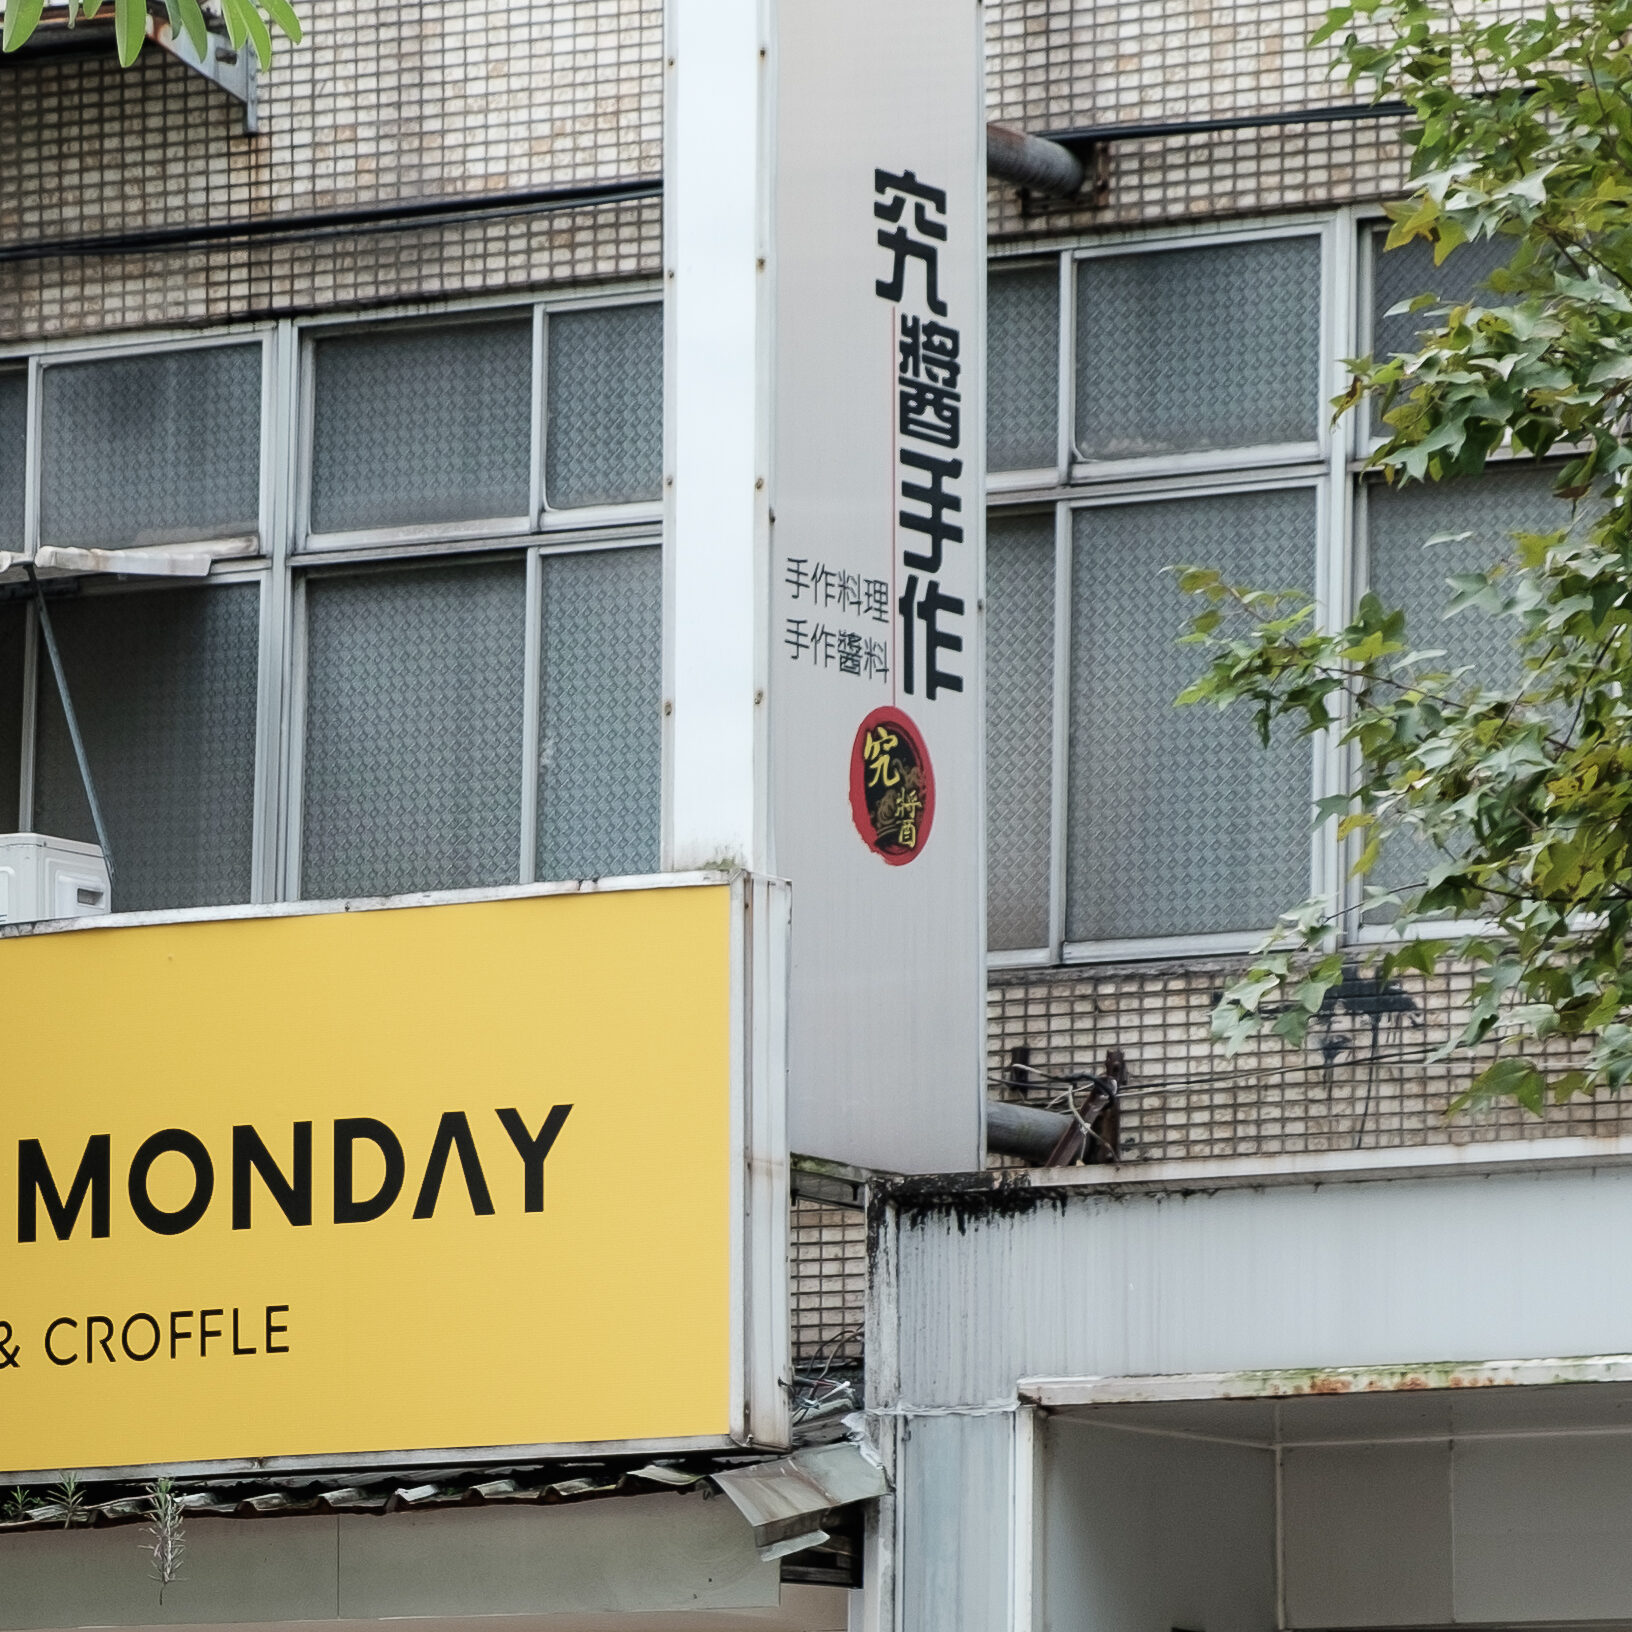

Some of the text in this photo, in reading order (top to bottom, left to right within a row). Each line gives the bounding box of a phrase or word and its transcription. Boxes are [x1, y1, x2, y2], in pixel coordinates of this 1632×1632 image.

[785, 557, 889, 623] 手作料理
[784, 618, 889, 683] 手作醬料
[18, 1103, 574, 1243] MONDAY
[44, 1304, 289, 1366] CROFFLE
